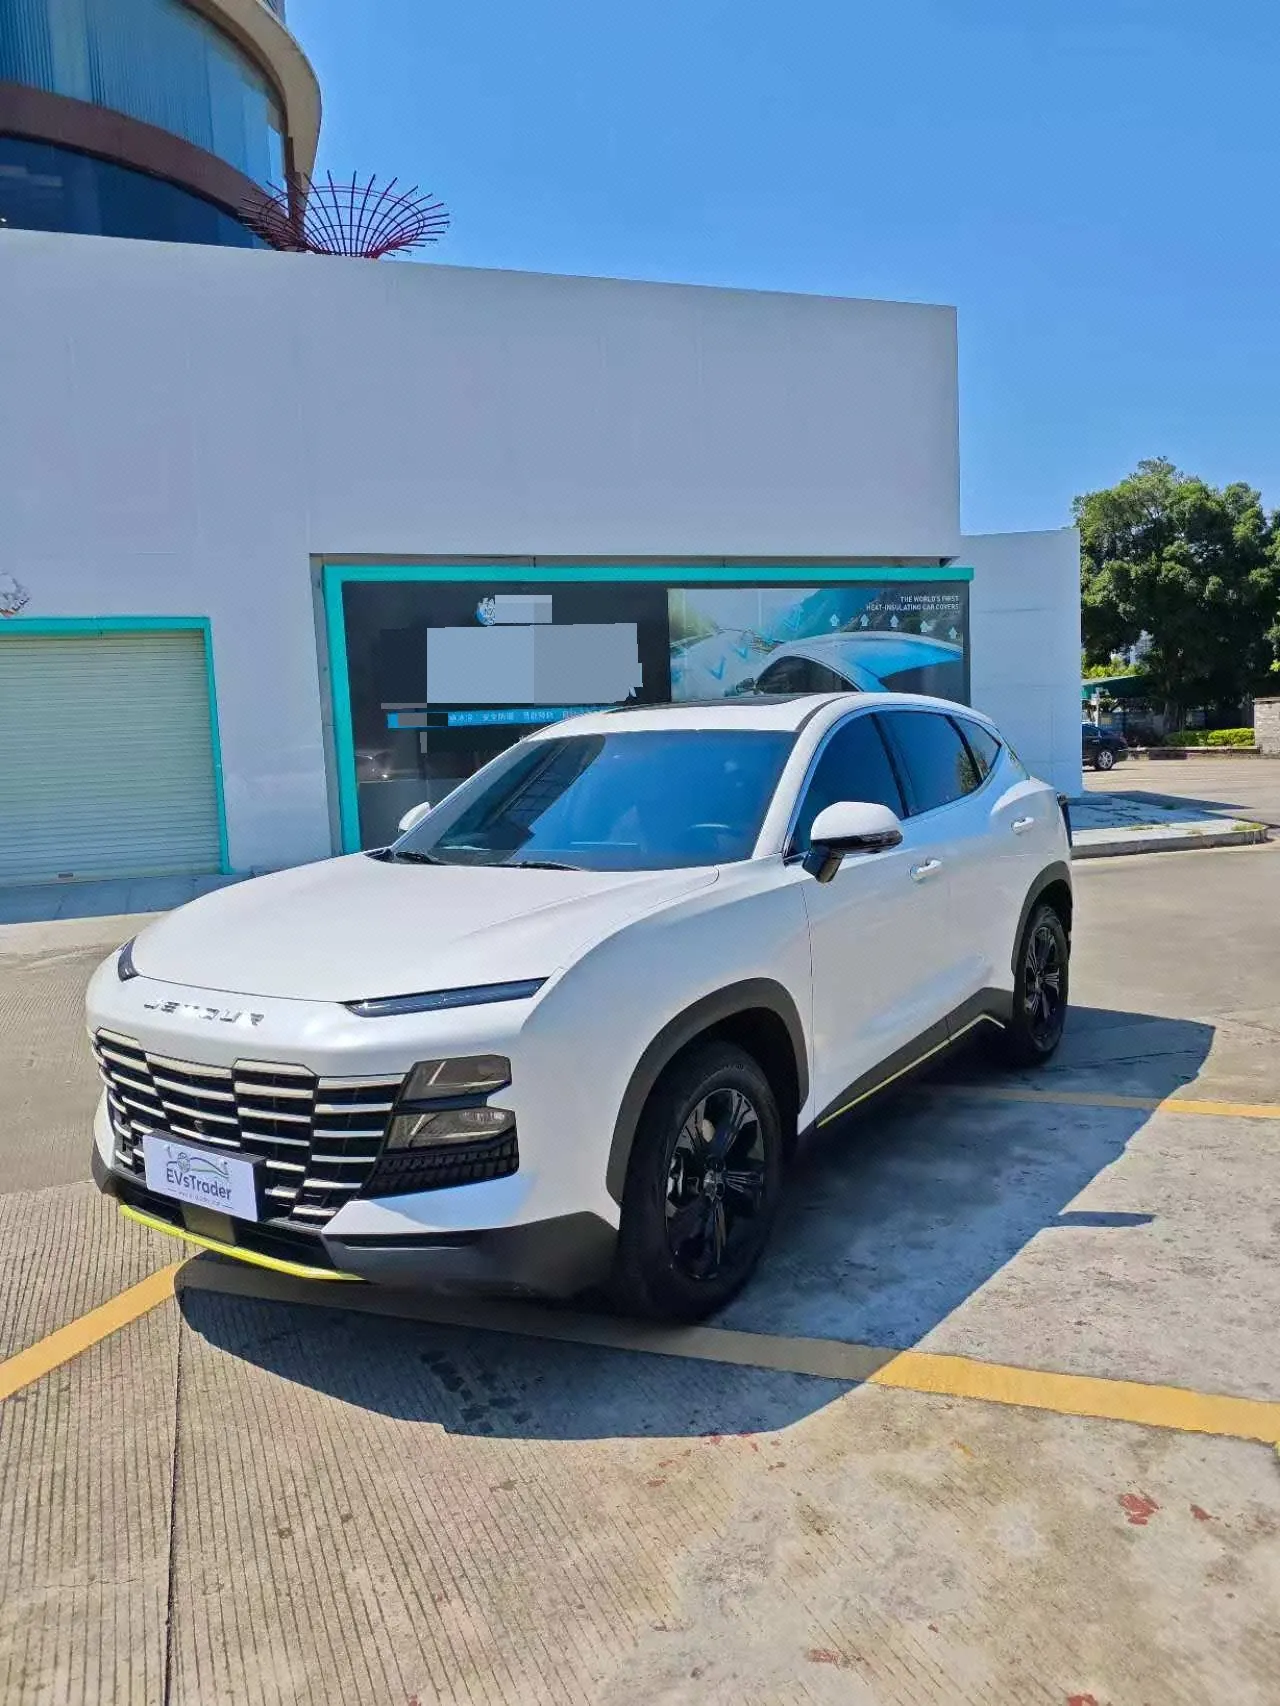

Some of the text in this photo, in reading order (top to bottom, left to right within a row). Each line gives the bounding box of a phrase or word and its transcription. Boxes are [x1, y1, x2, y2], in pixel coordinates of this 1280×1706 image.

[900, 595, 913, 603] THE
[866, 603, 959, 611] HEAT-INSULATING CAR COVERS
[166, 1167, 232, 1200] EVsTrader
